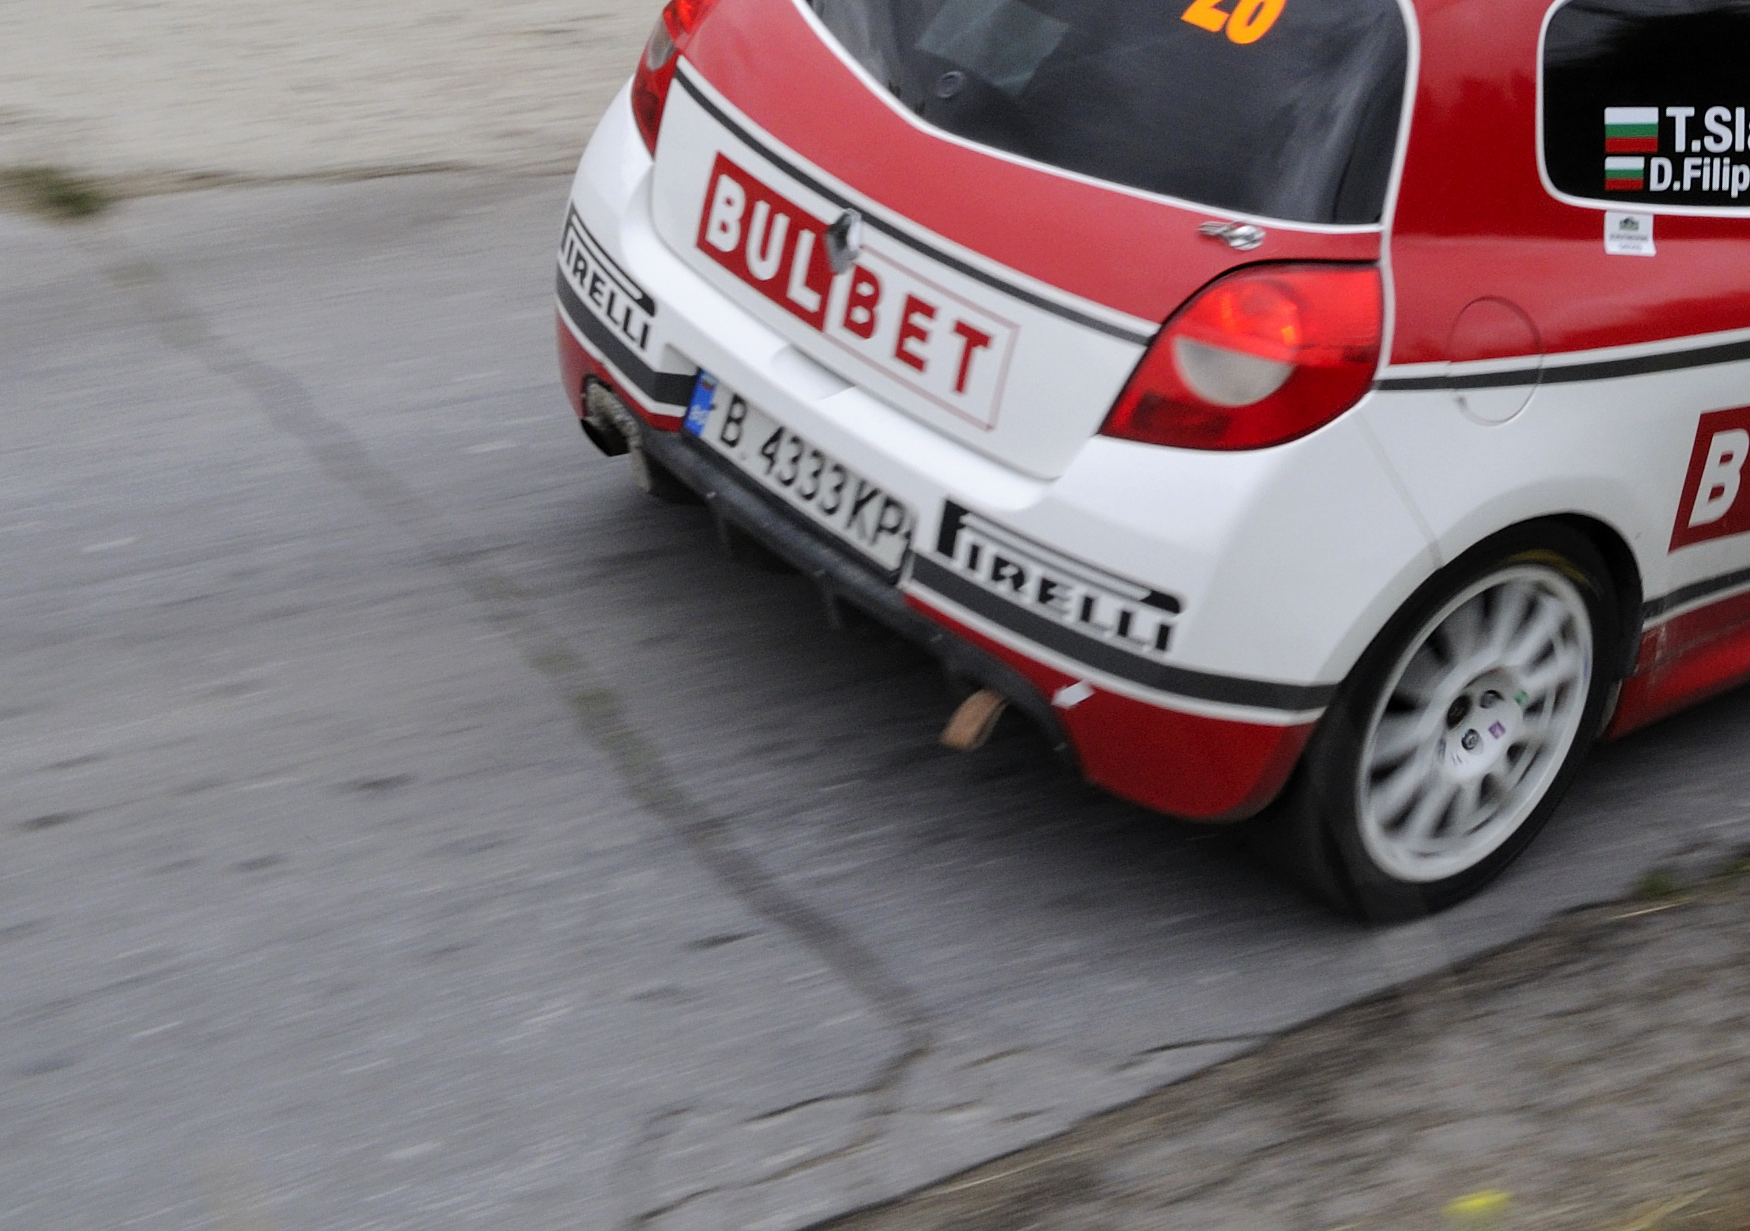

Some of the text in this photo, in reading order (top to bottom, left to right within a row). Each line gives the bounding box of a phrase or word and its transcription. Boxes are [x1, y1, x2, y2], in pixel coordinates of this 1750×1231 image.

[561, 198, 657, 351] PIRELLI
[704, 173, 996, 395] BULBET
[720, 393, 749, 448] B
[936, 493, 1188, 653] PIRELLI
